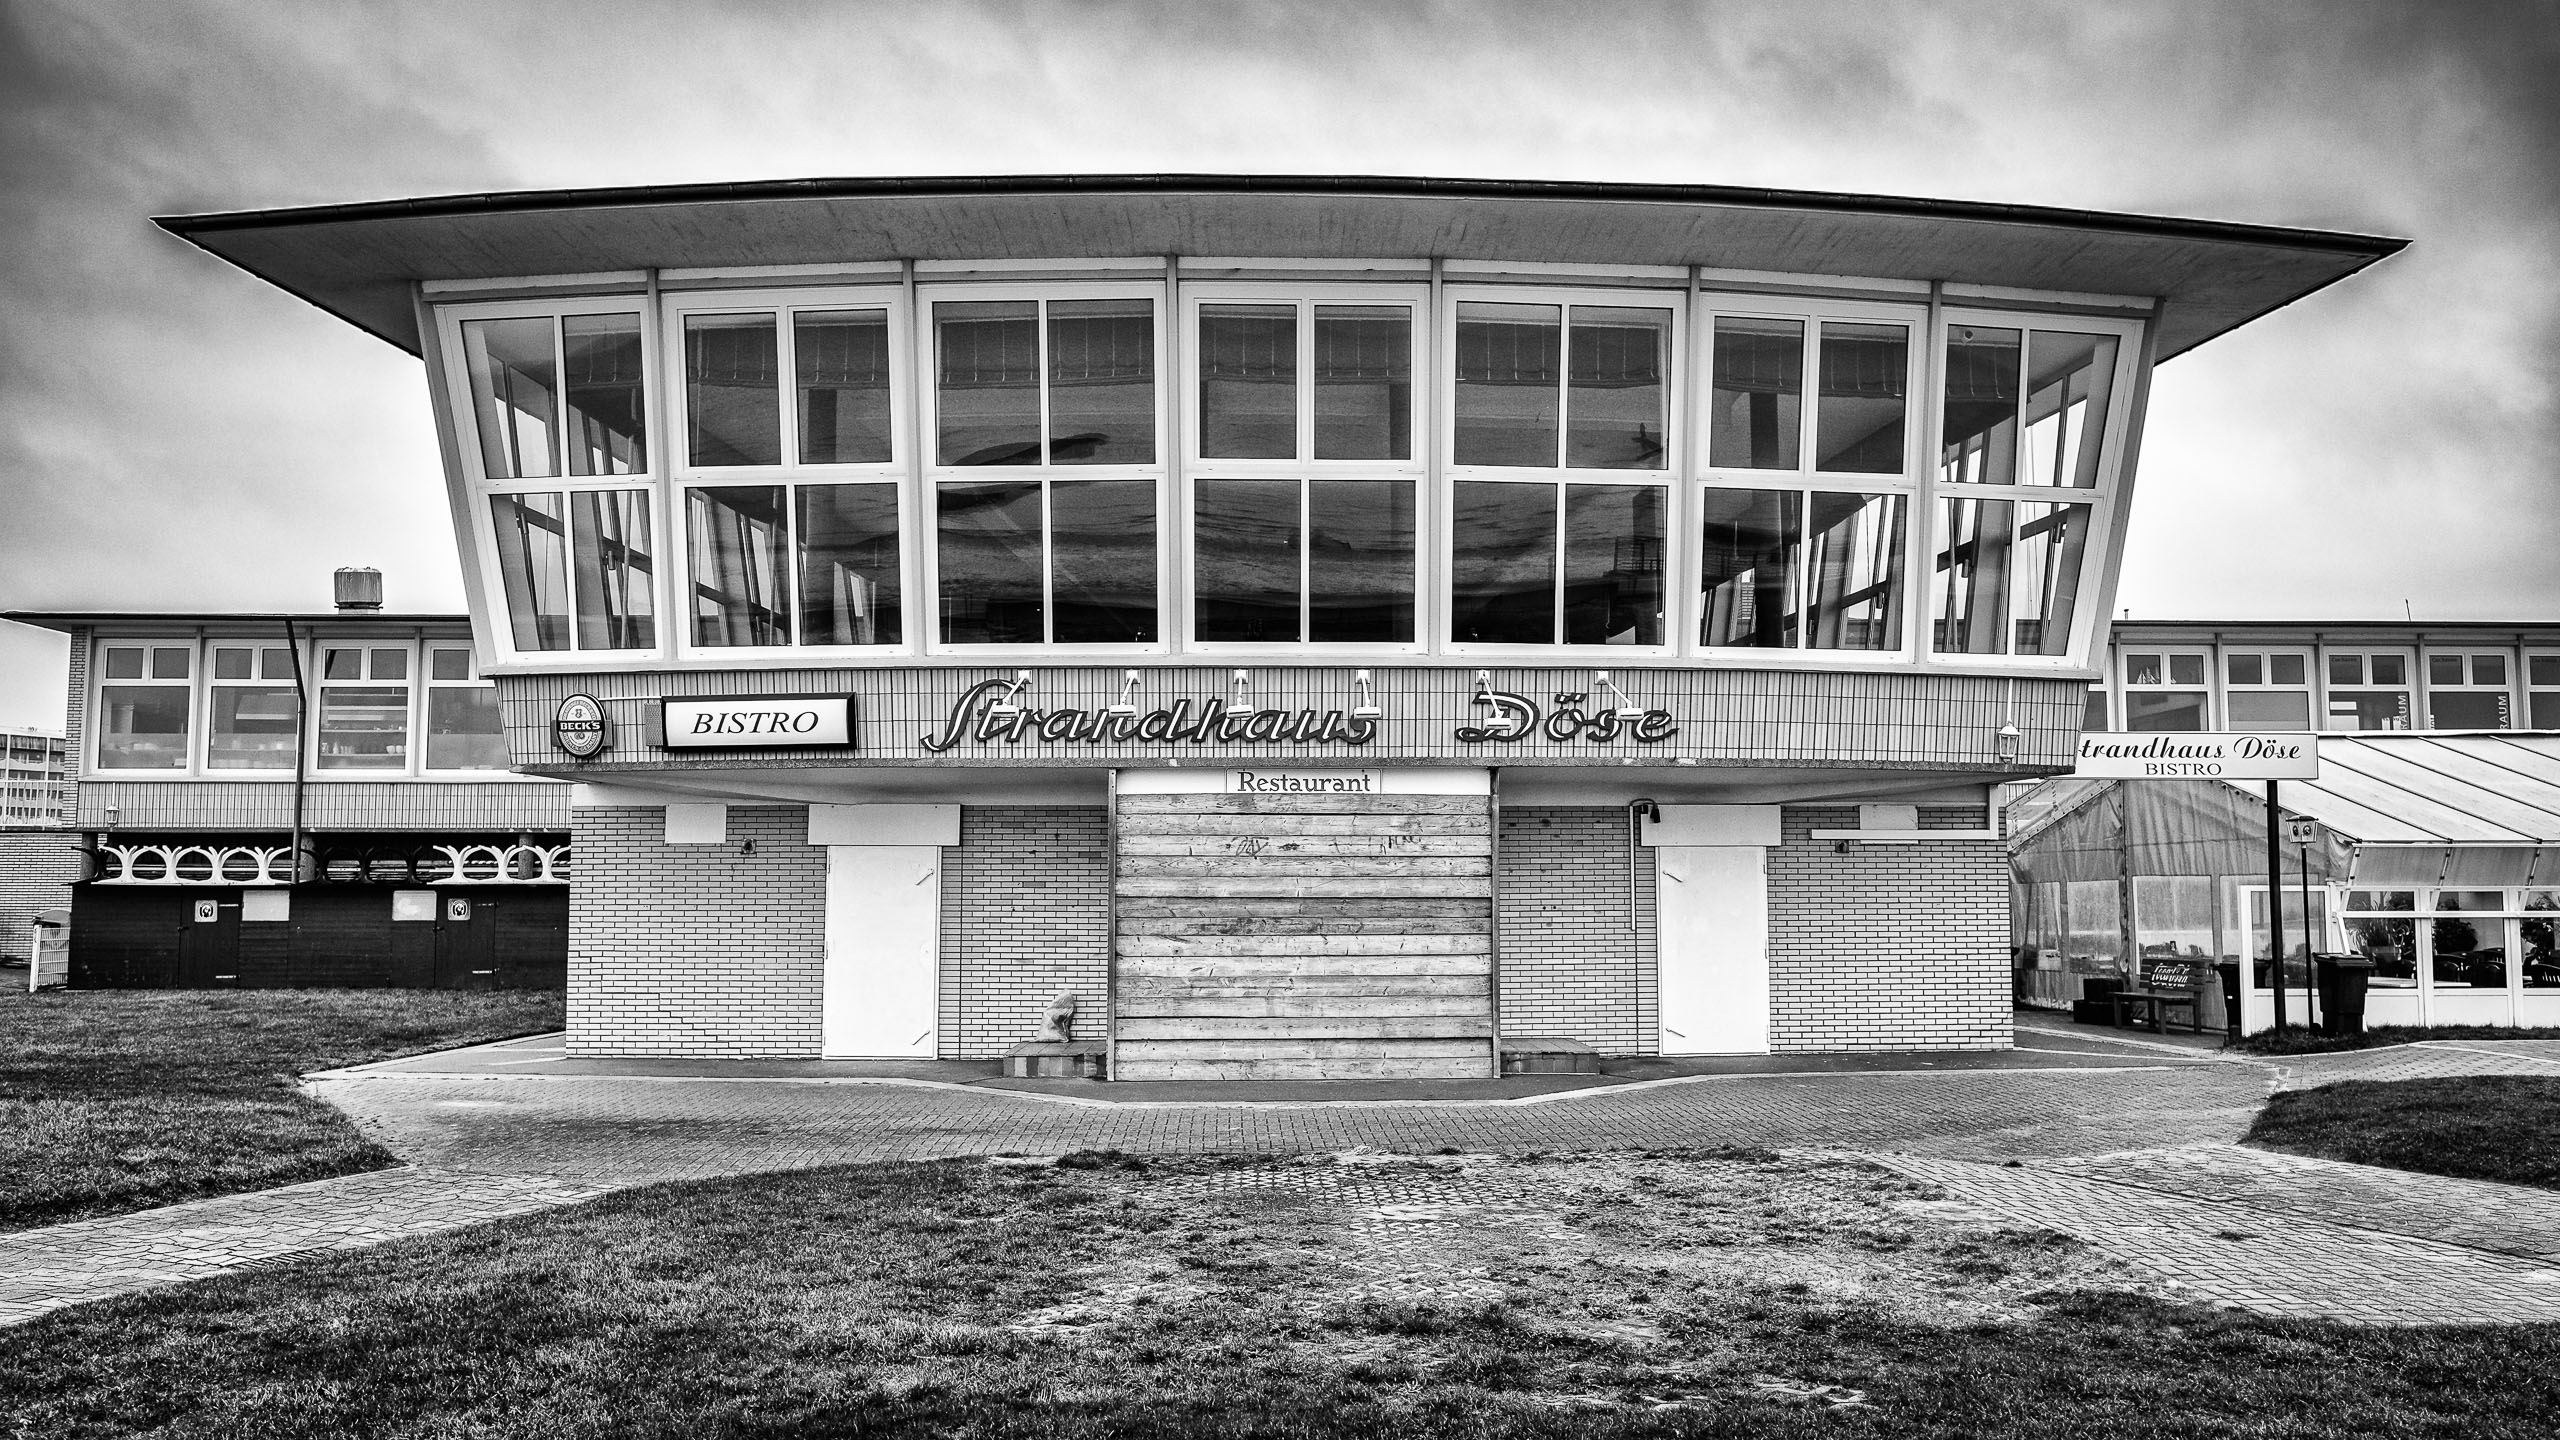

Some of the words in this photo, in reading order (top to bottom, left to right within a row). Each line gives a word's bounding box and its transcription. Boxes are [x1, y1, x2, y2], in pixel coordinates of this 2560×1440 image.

[559, 720, 601, 731] BECK'S
[690, 711, 819, 734] BISTRO
[920, 678, 1377, 752] Strandhaus
[1454, 690, 1680, 743] Döse
[2077, 736, 2226, 759] trandhaus
[2233, 736, 2301, 760] Döse
[2145, 763, 2222, 776] BISTRO
[1237, 770, 1371, 793] Restaurant
